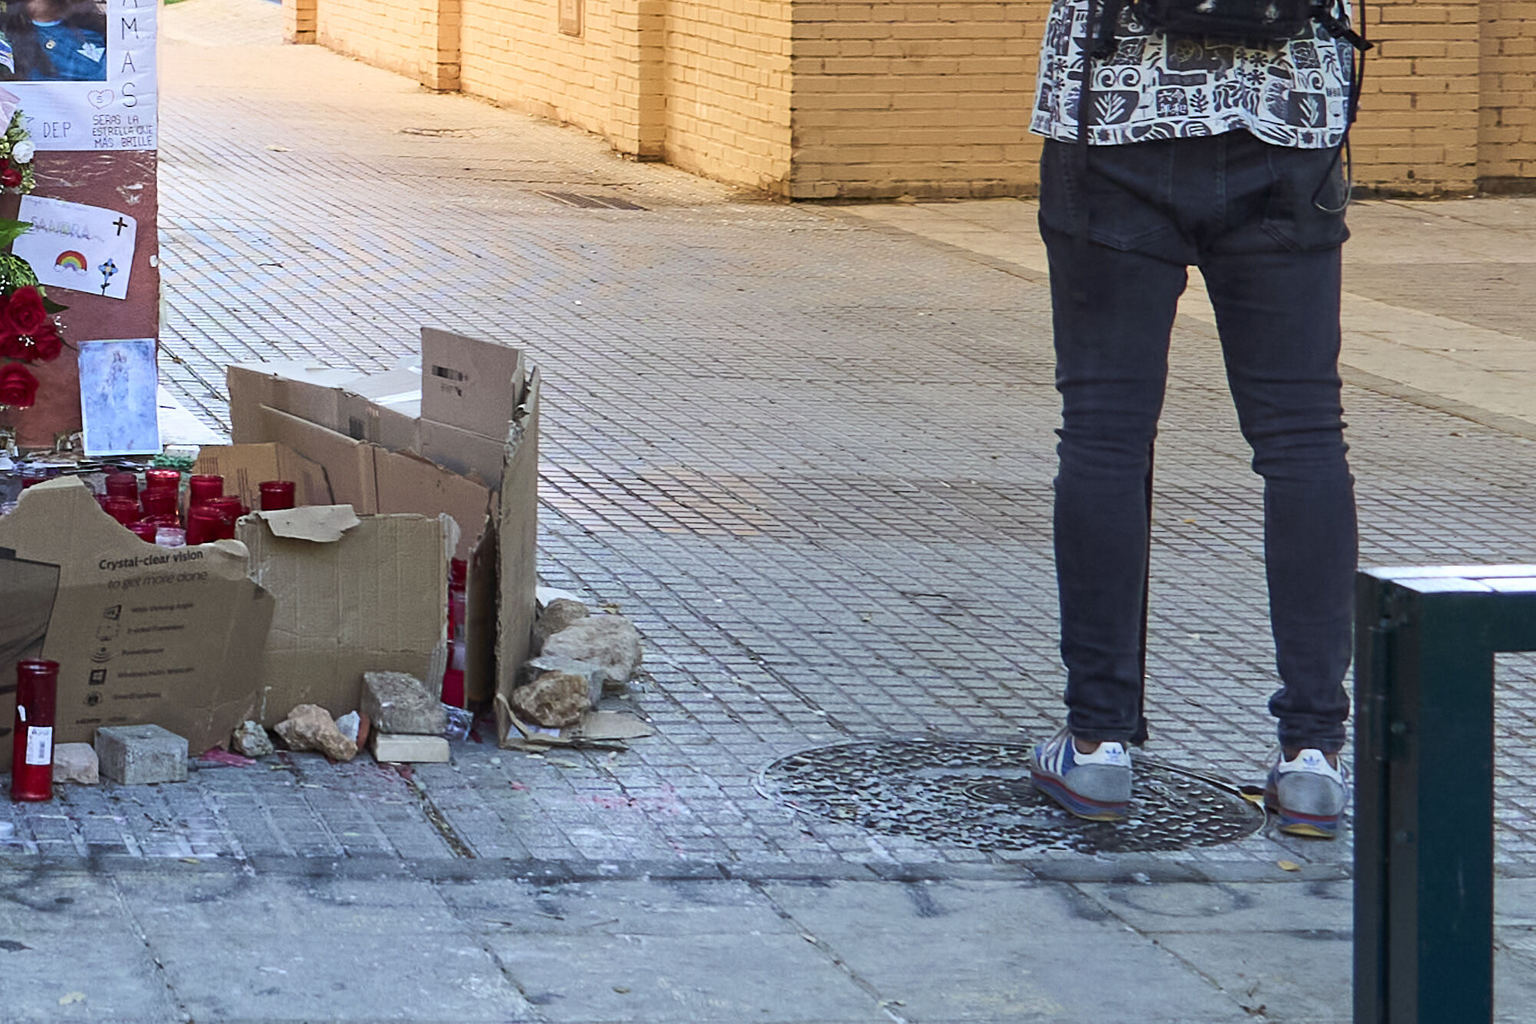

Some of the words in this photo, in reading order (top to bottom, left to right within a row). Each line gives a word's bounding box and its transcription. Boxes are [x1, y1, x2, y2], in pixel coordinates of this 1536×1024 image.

[127, 115, 140, 124] LA
[98, 552, 170, 571] Crystal-clear
[173, 549, 204, 564] vision
[107, 579, 121, 589] to
[142, 574, 176, 587] more
[178, 570, 209, 584] done
